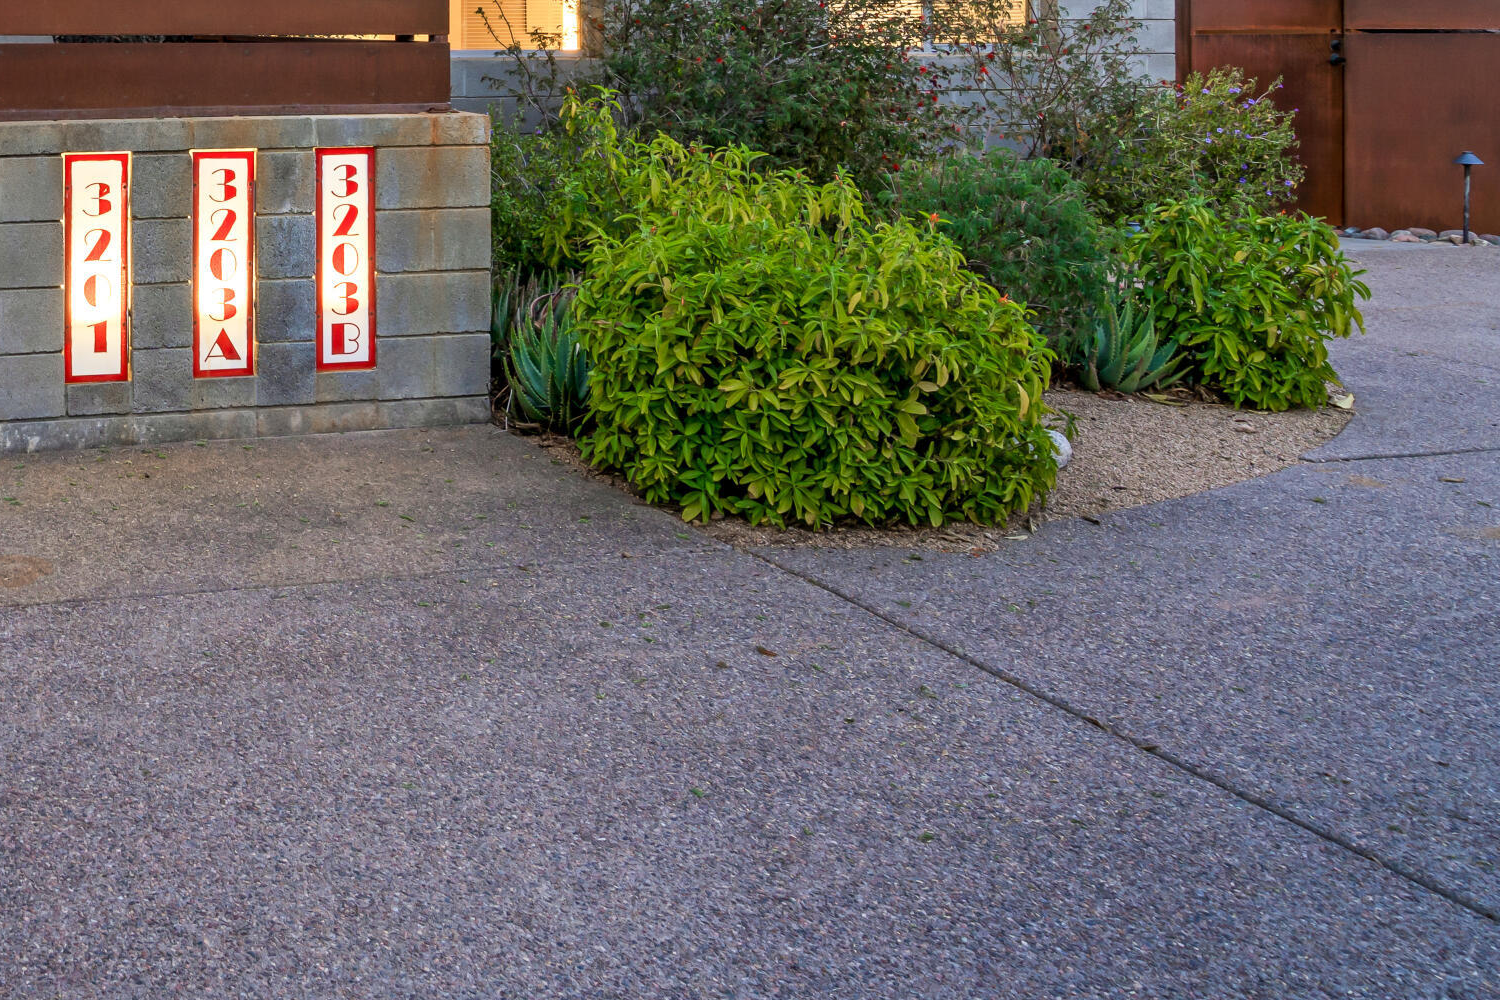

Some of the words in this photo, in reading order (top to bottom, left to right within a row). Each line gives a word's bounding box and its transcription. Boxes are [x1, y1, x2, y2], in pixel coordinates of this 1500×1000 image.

[82, 182, 112, 353] 3201
[204, 168, 241, 361] 3203A
[331, 164, 361, 355] 3203B
